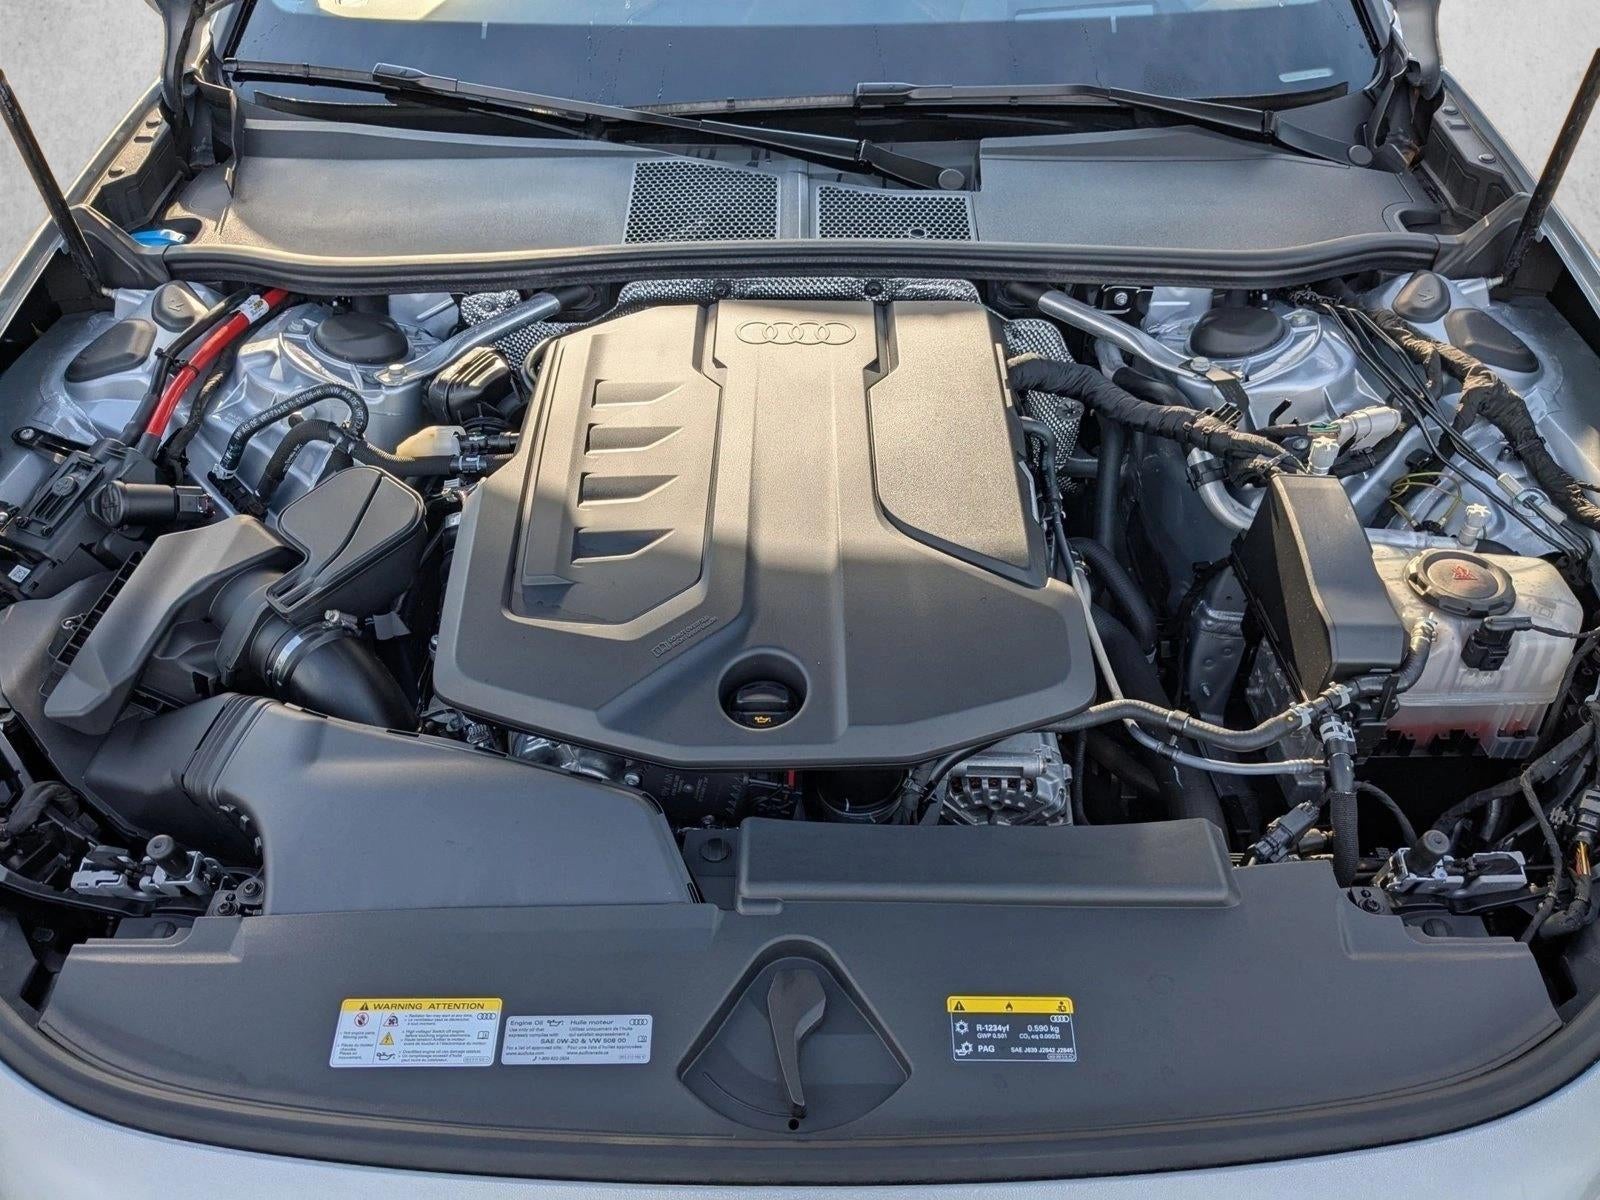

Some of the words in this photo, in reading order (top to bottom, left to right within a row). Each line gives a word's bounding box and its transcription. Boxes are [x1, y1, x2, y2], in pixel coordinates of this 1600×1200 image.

[976, 1024, 1010, 1033] R-1234yf
[1027, 1024, 1048, 1032] 0.590
[1050, 1024, 1060, 1034] kg
[978, 1045, 995, 1053] PAG
